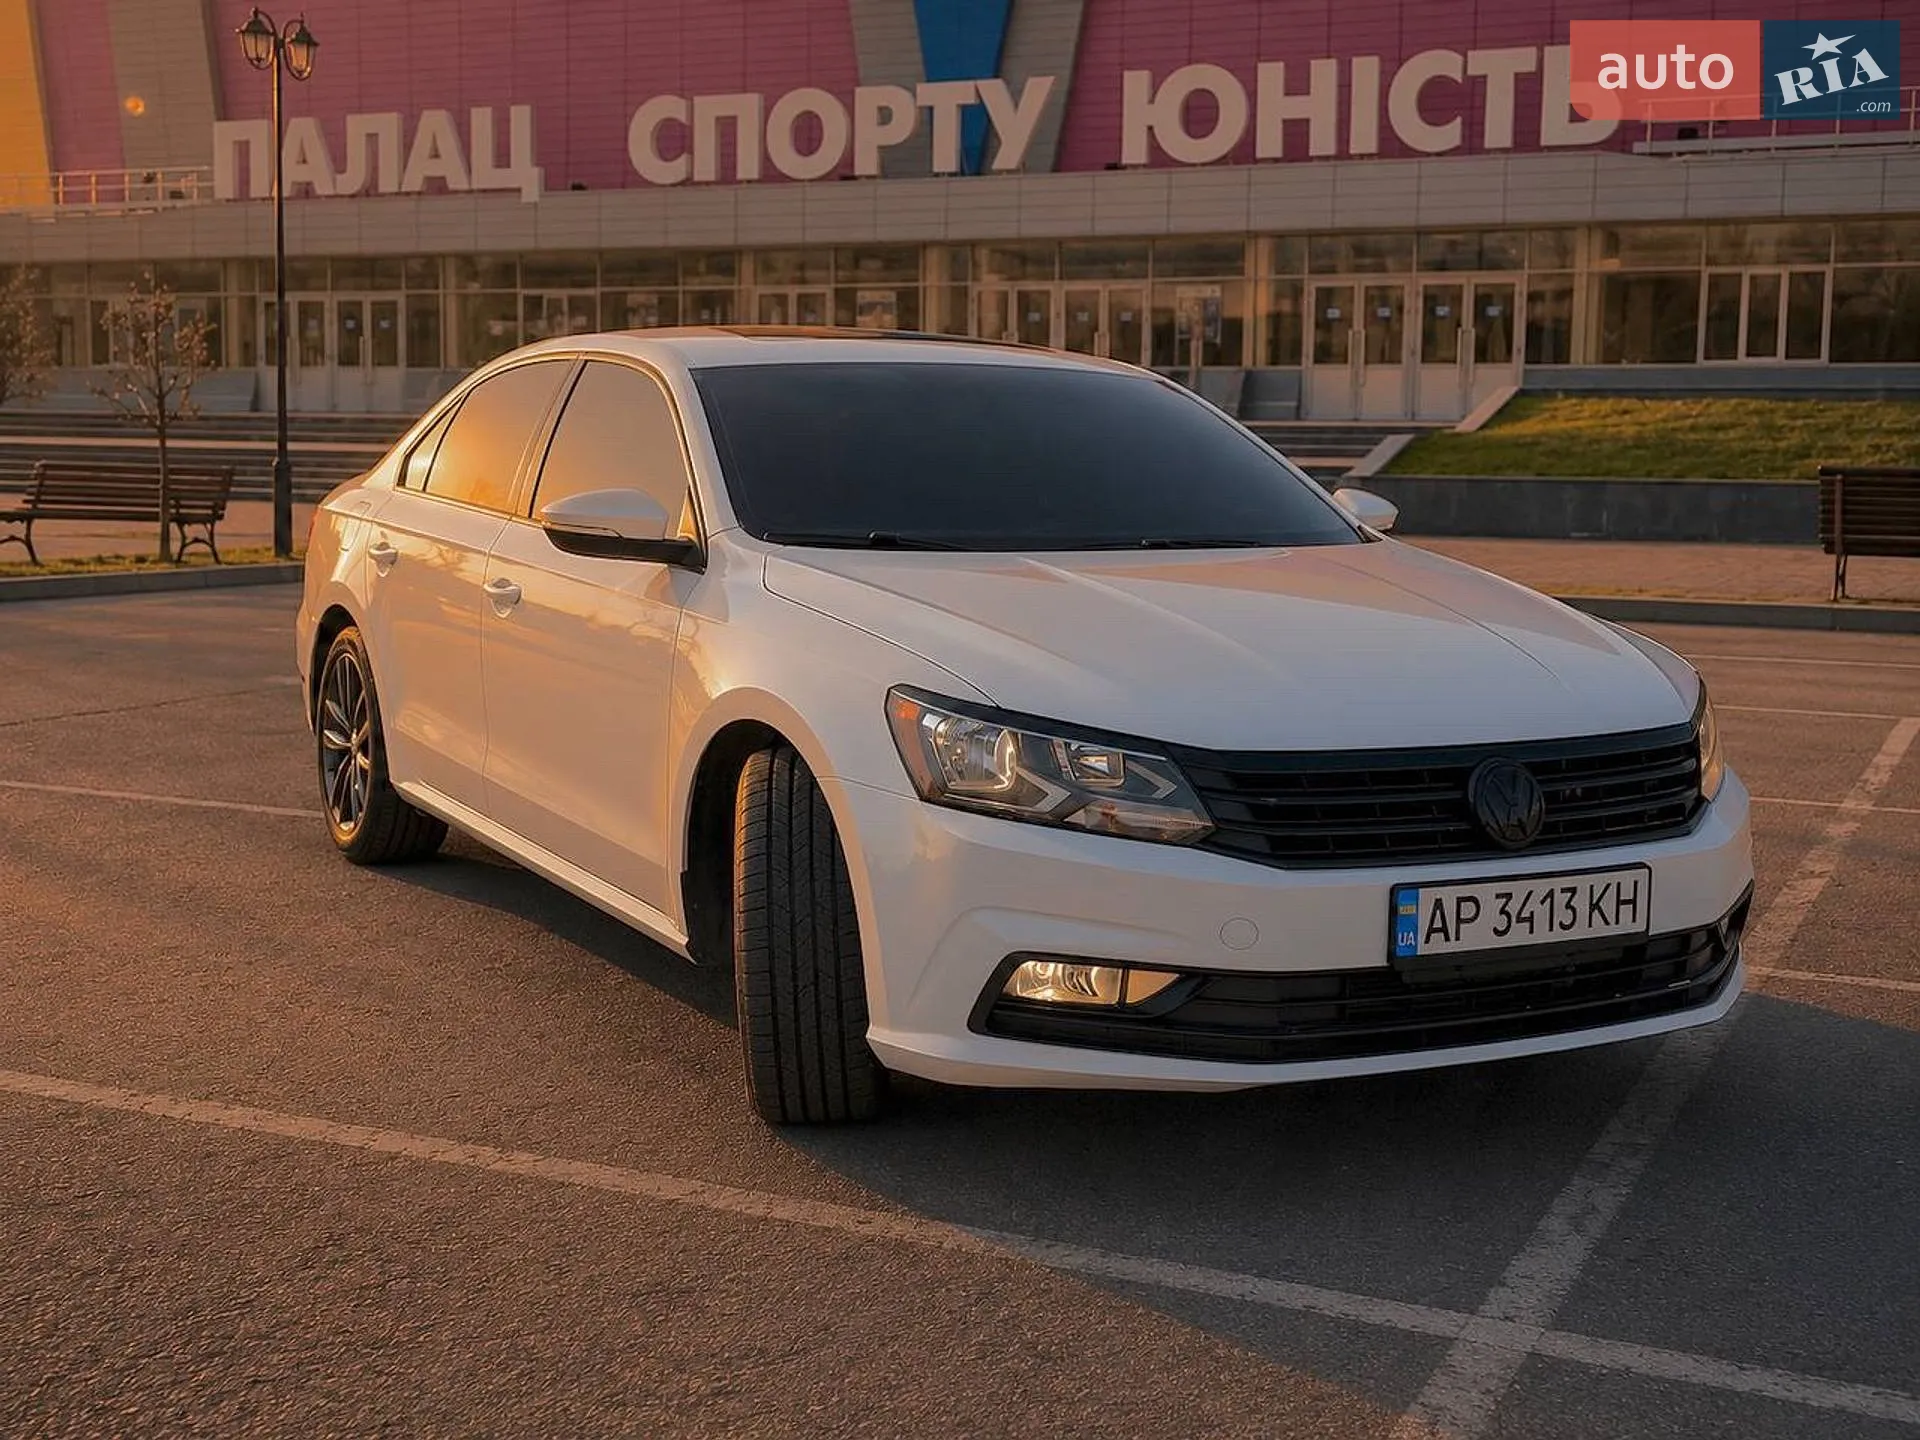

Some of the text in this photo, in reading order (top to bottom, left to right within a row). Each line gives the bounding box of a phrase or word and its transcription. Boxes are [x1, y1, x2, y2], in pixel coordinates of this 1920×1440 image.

[213, 45, 1622, 203] ПАЛАЦ СПОРТУ ЮНІСТЬ
[1398, 931, 1416, 946] UA
[1424, 880, 1638, 944] AP 3413 KH
